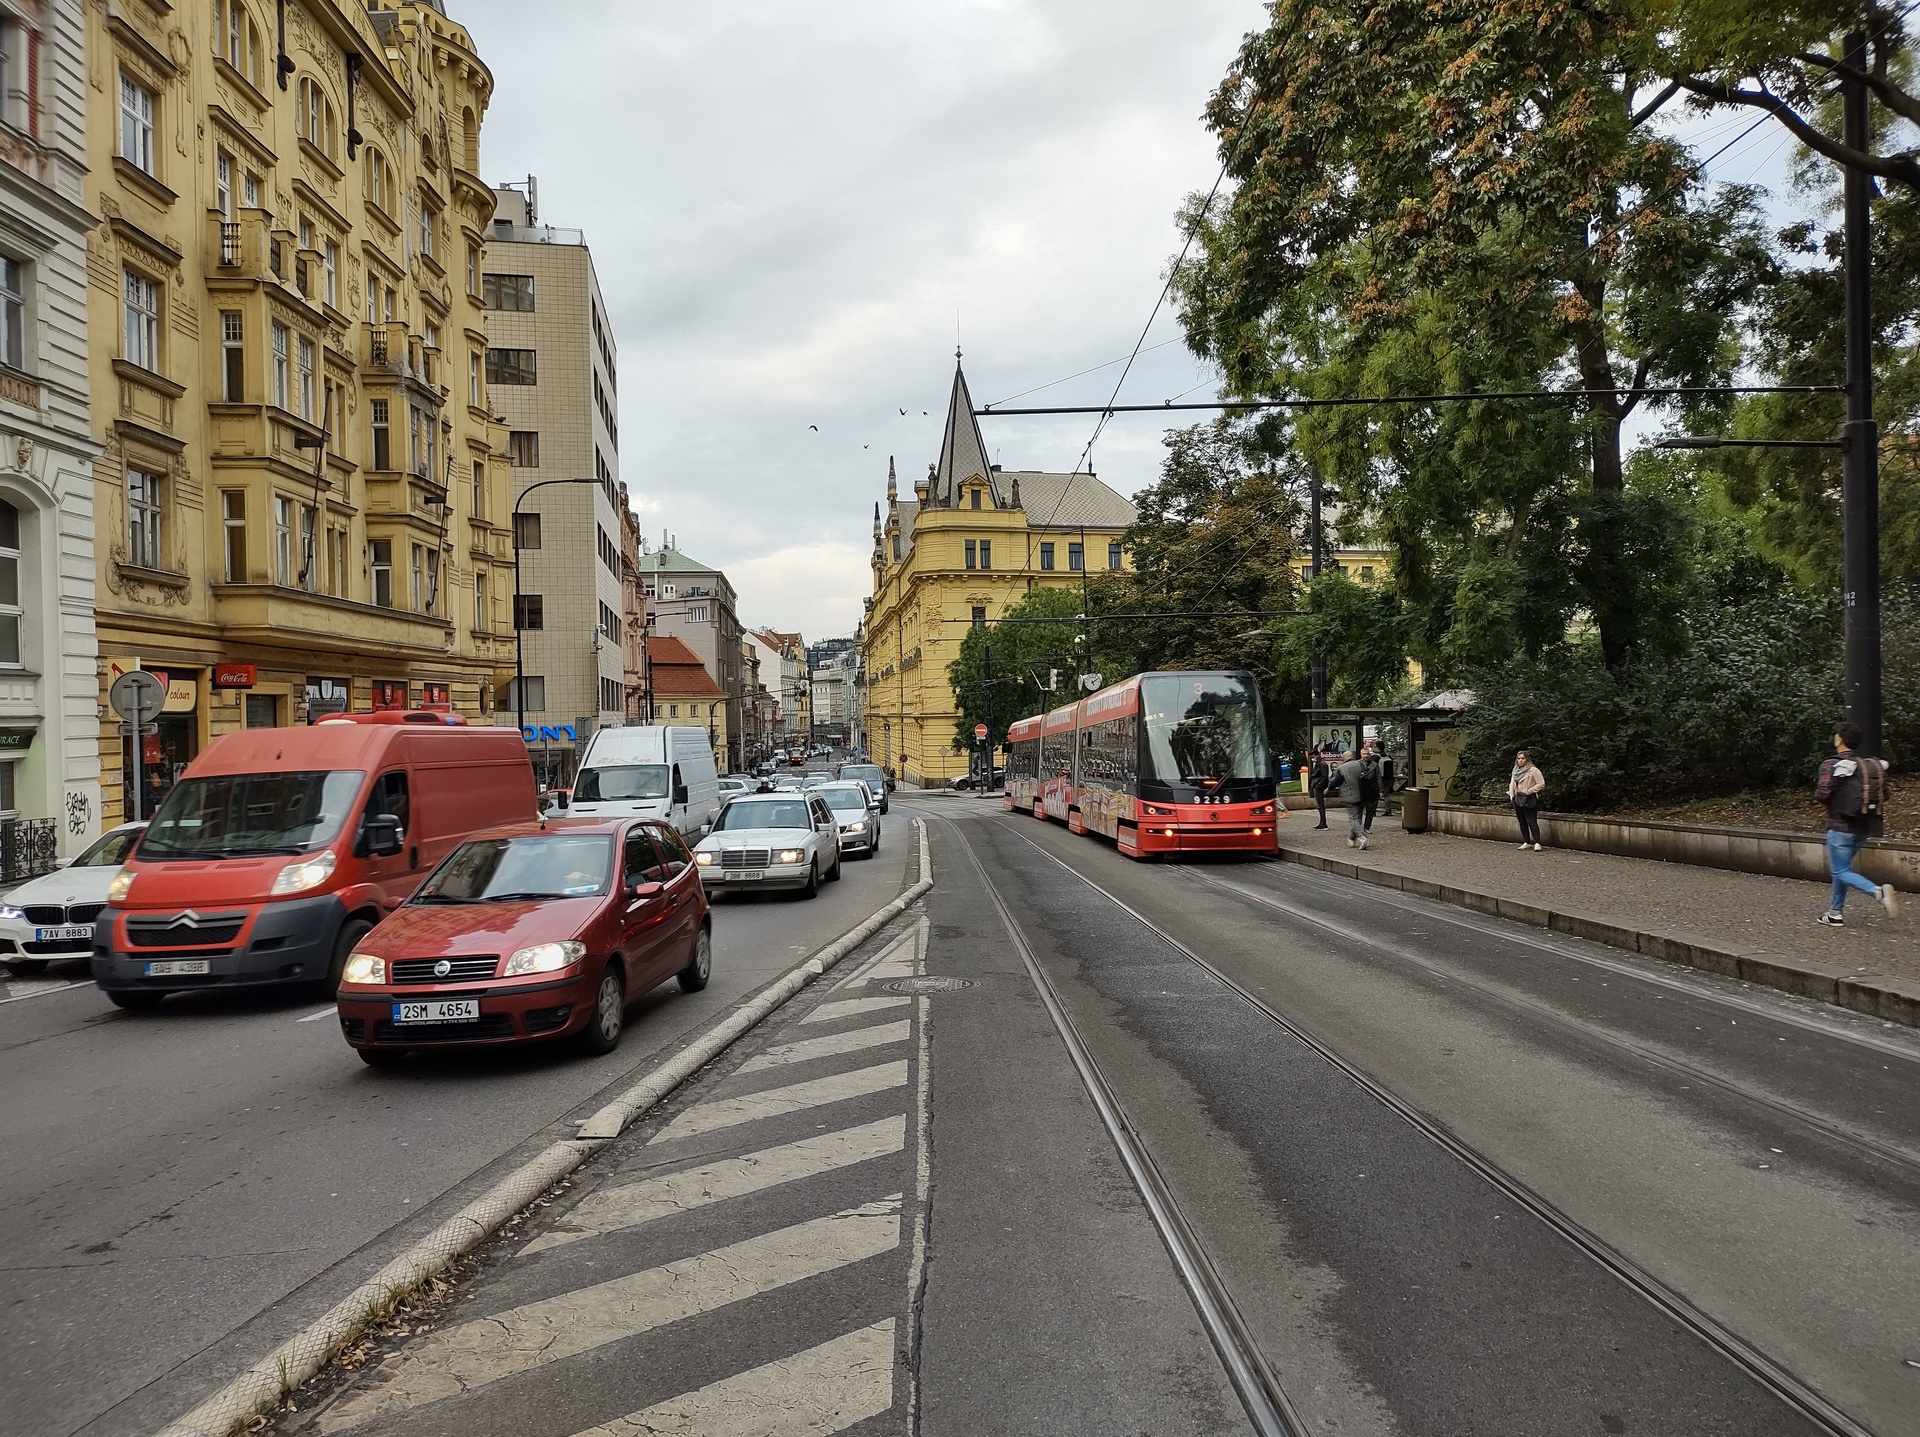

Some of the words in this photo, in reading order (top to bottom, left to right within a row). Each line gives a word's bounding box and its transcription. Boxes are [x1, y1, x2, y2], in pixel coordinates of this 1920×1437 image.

[170, 686, 190, 700] colour
[1193, 682, 1204, 695] 3
[521, 725, 577, 742] ONY
[1193, 795, 1230, 804] 9229
[43, 929, 60, 939] 7AV
[65, 928, 88, 938] 8883
[403, 1004, 429, 1019] 2SM
[438, 1002, 472, 1018] 4654
